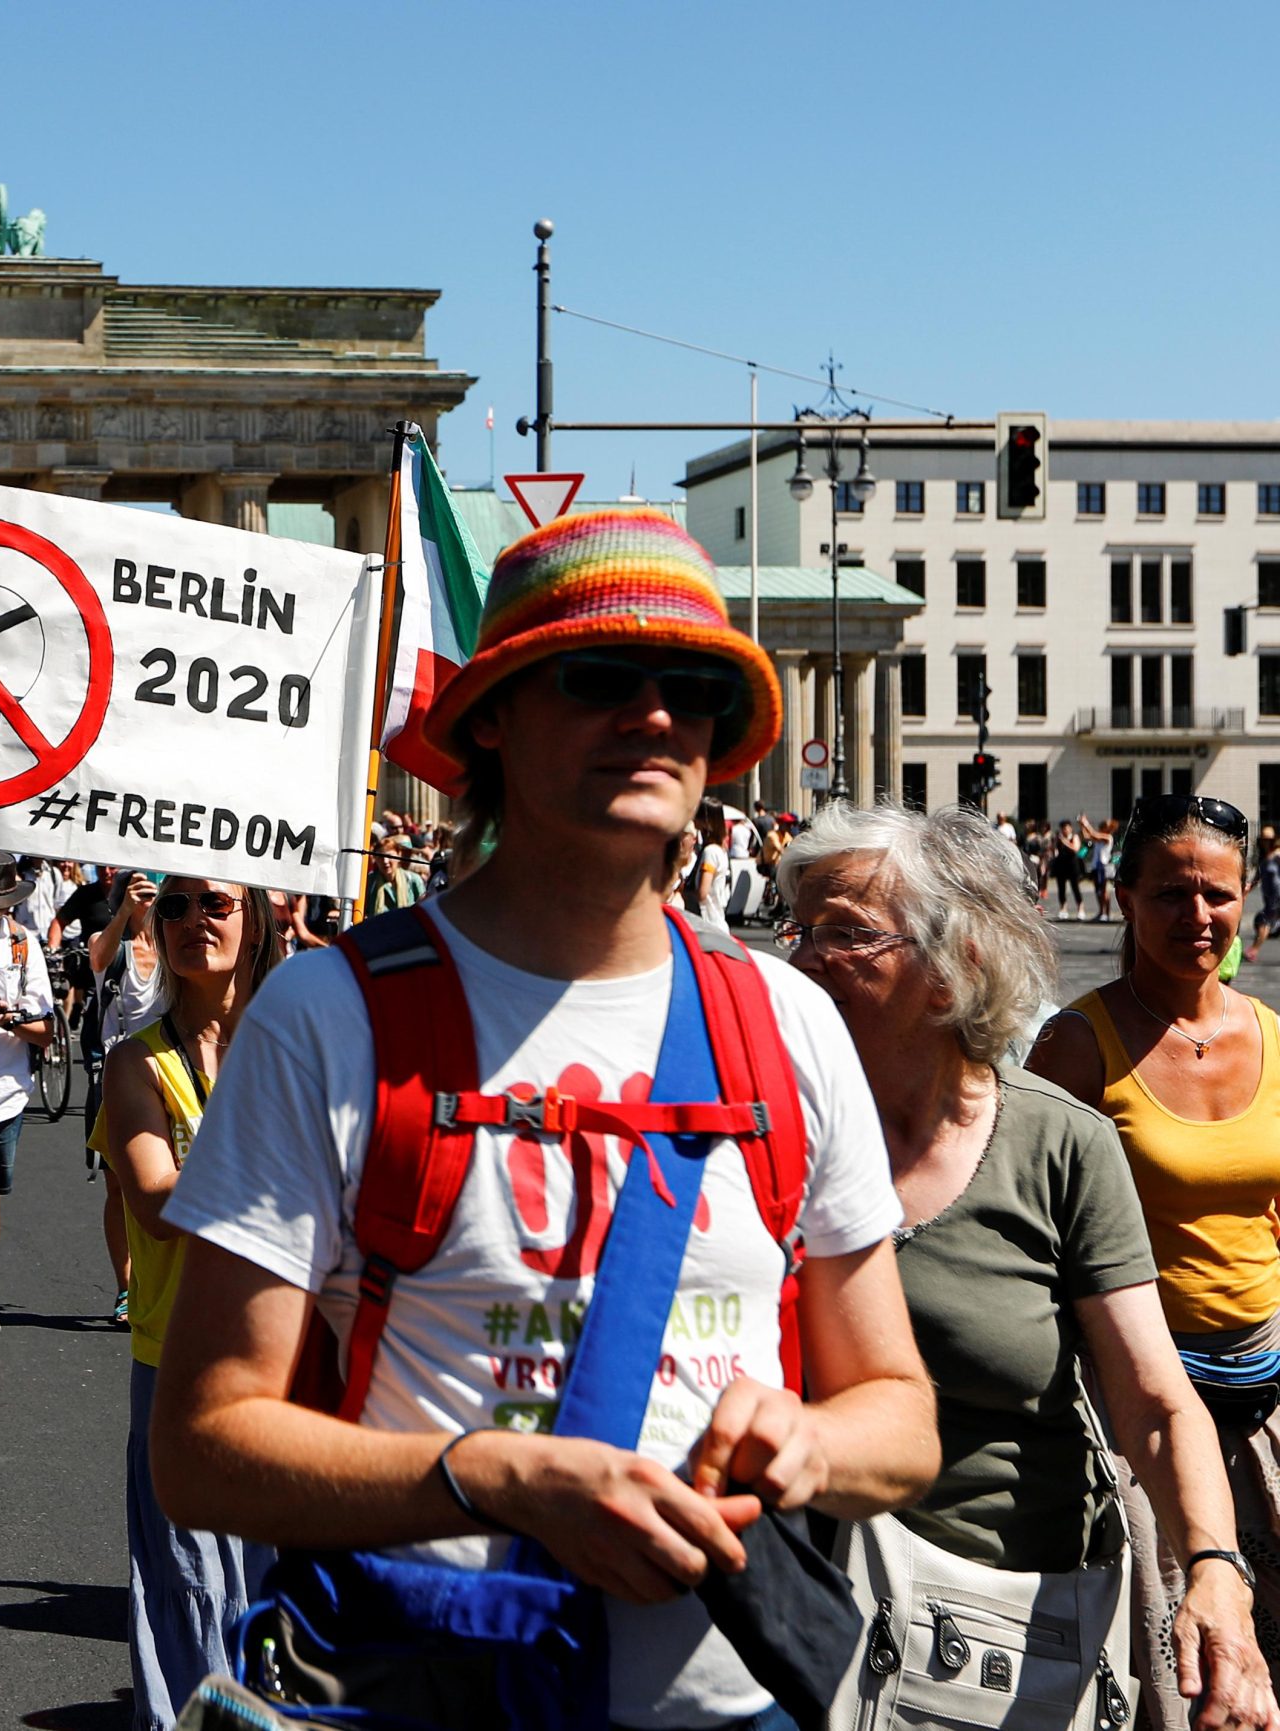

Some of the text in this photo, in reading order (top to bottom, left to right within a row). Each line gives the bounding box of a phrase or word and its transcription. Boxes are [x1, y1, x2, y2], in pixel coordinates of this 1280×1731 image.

[134, 646, 312, 729] 2020
[28, 789, 317, 866] #FREEDOM
[689, 1354, 747, 1389] 2016
